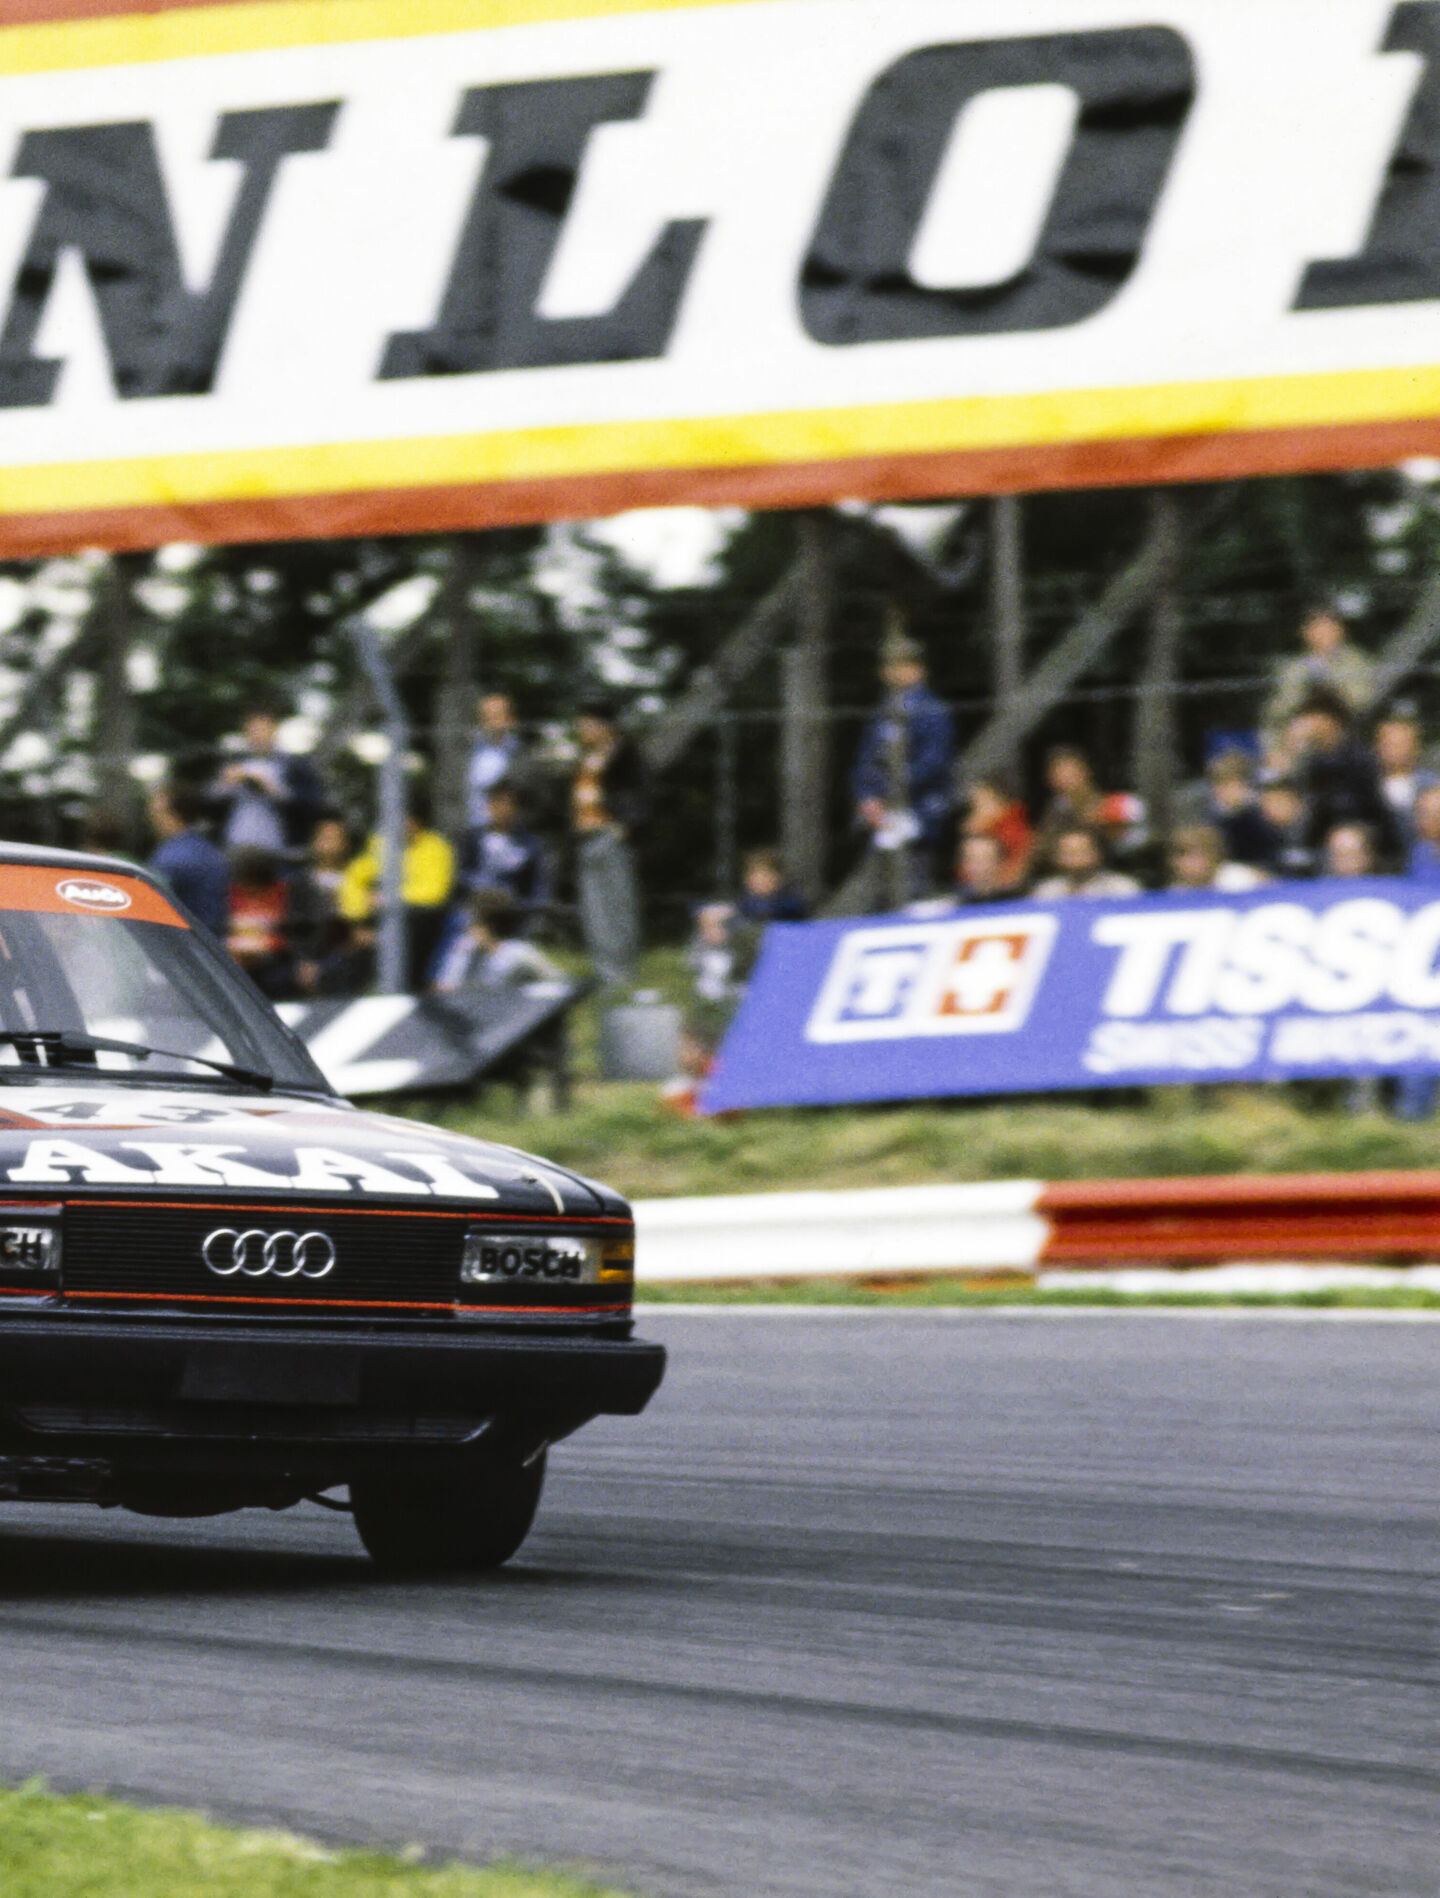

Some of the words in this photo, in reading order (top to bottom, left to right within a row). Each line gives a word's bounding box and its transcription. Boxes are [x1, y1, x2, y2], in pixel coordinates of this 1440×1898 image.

[64, 884, 125, 904] Audi
[28, 1101, 230, 1123] 43
[6, 1139, 500, 1199] AKAI
[480, 1248, 581, 1279] BOSCH
